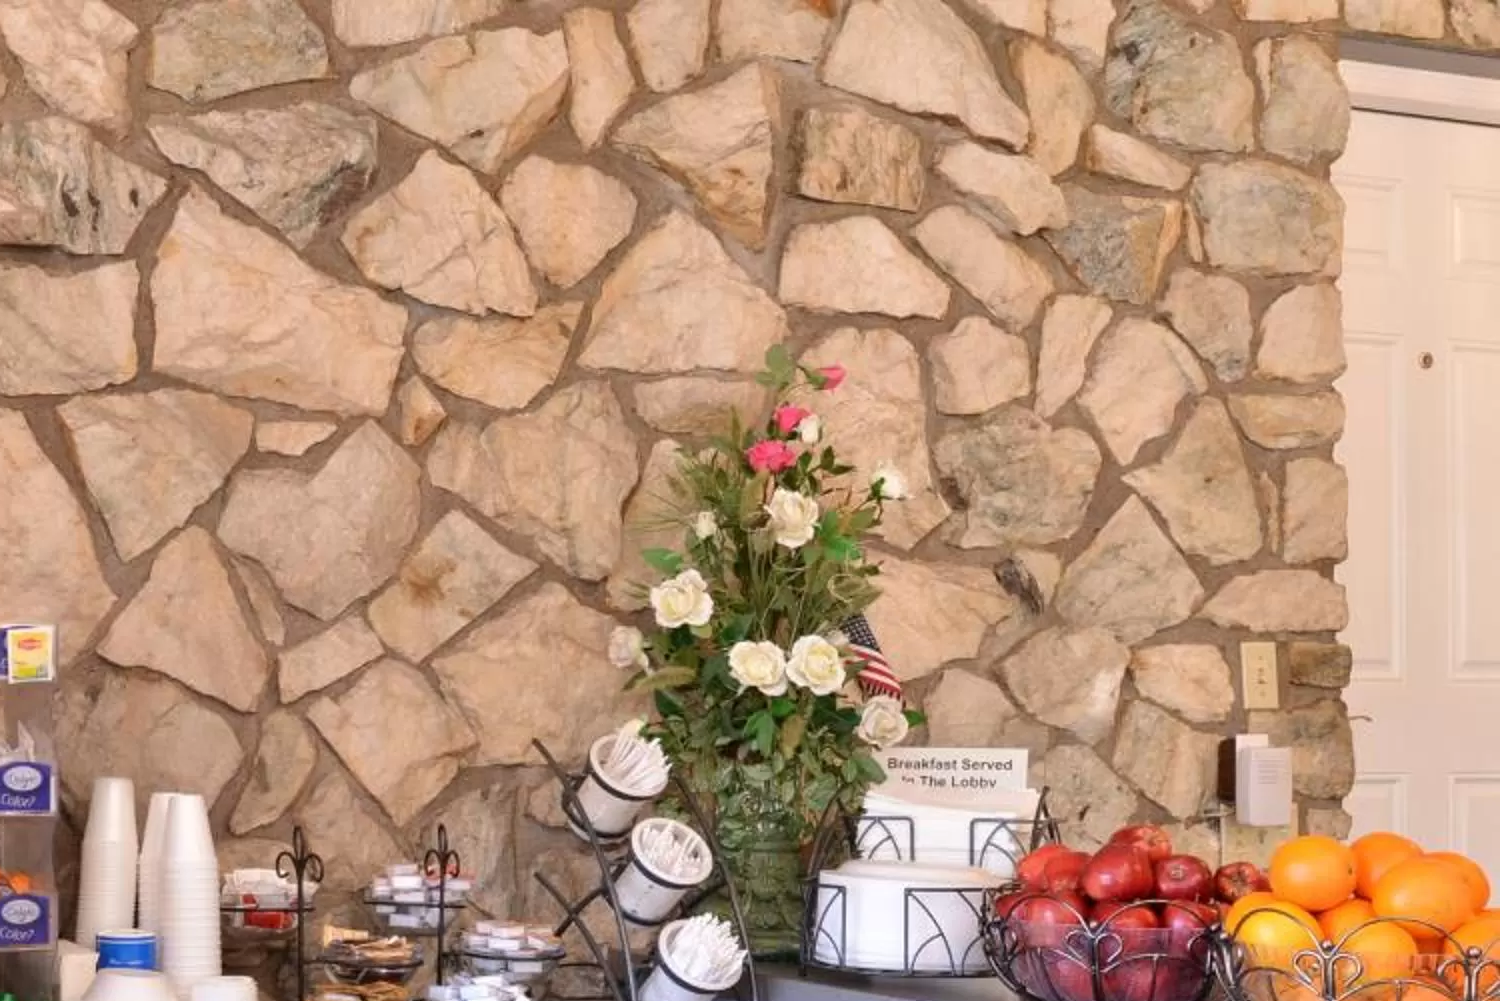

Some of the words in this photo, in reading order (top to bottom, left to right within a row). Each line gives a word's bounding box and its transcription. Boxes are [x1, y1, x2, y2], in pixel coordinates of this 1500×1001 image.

[887, 757, 958, 770] Breakfast
[961, 758, 1013, 771] Served
[920, 776, 946, 788] The
